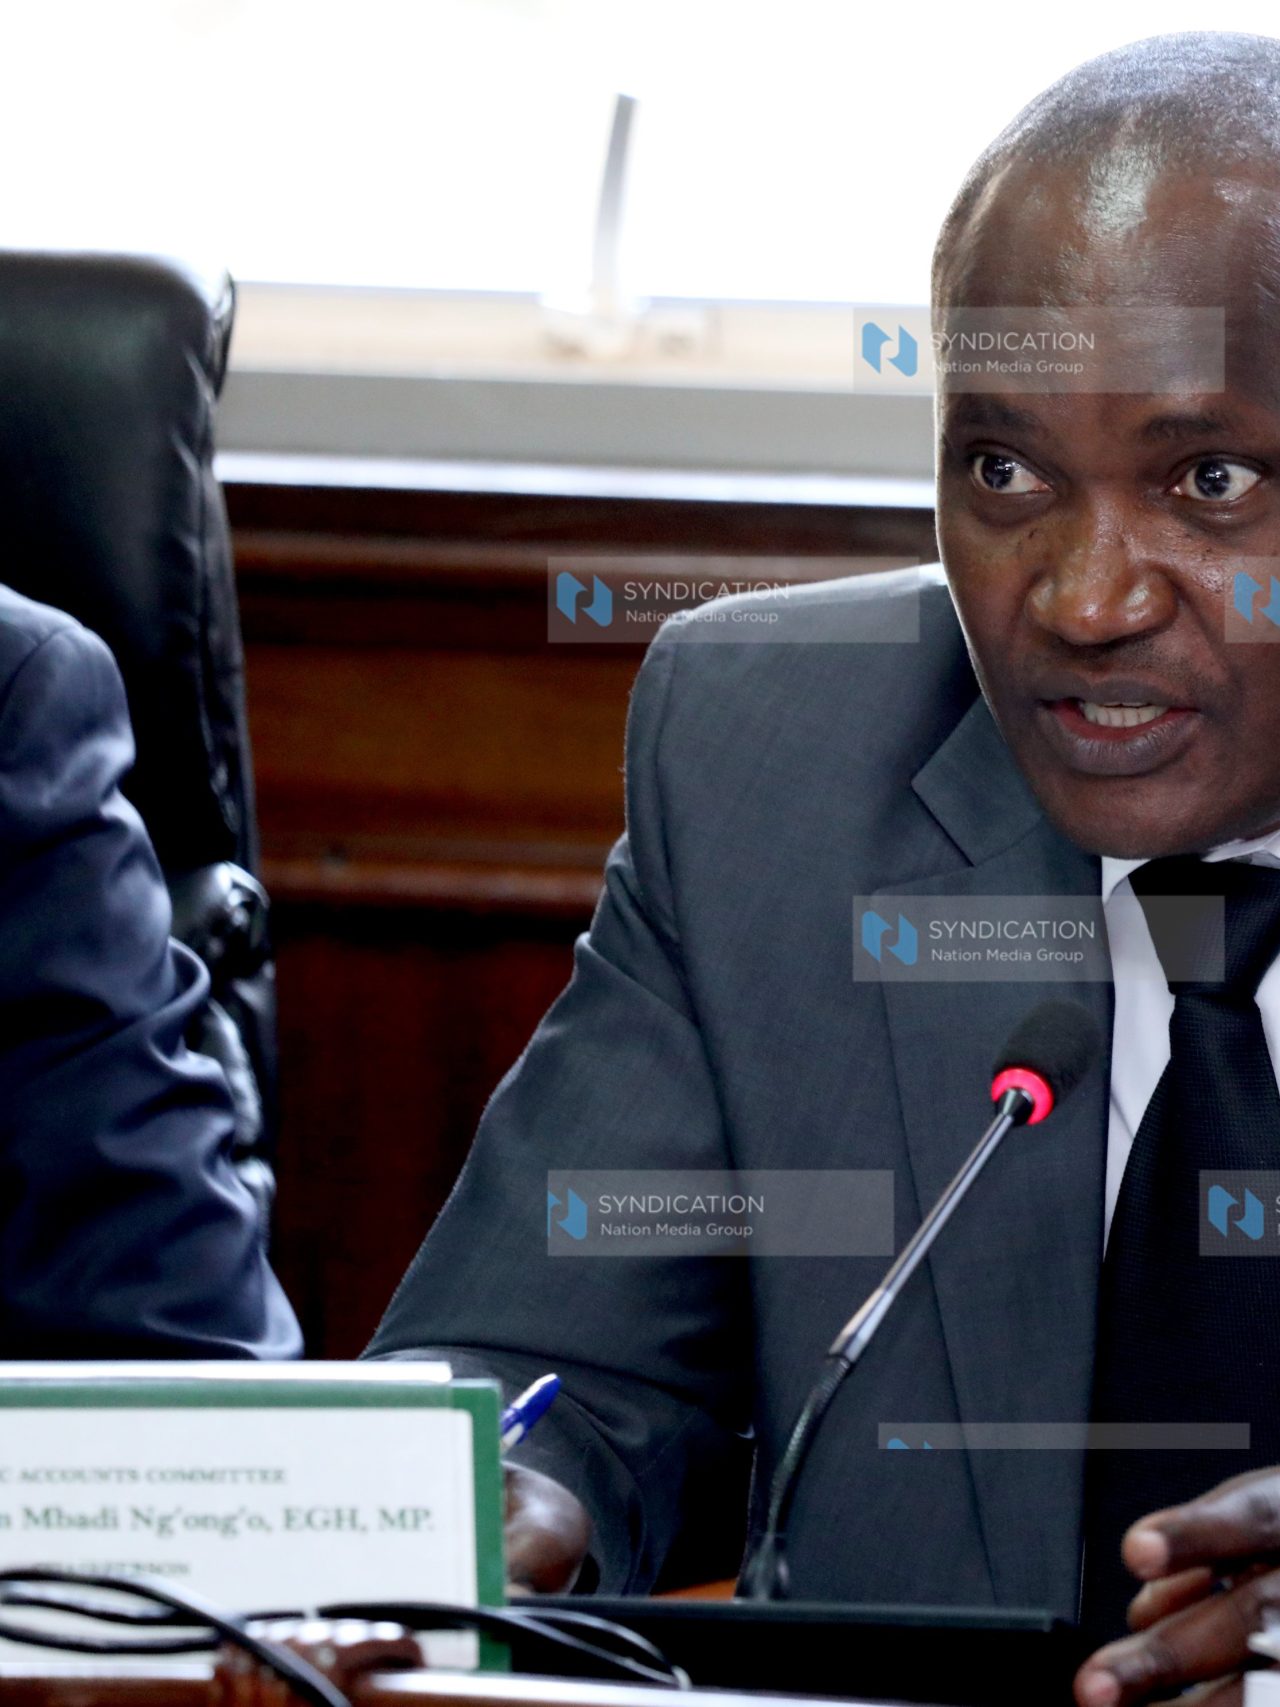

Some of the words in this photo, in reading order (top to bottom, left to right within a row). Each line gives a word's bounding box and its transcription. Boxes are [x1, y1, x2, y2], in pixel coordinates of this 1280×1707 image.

[20, 1467, 140, 1484] ACCOUNTS
[146, 1467, 286, 1484] COMMITTEE
[21, 1505, 119, 1530] Mbadi
[283, 1507, 369, 1533] EGH,
[378, 1507, 435, 1532] MP.
